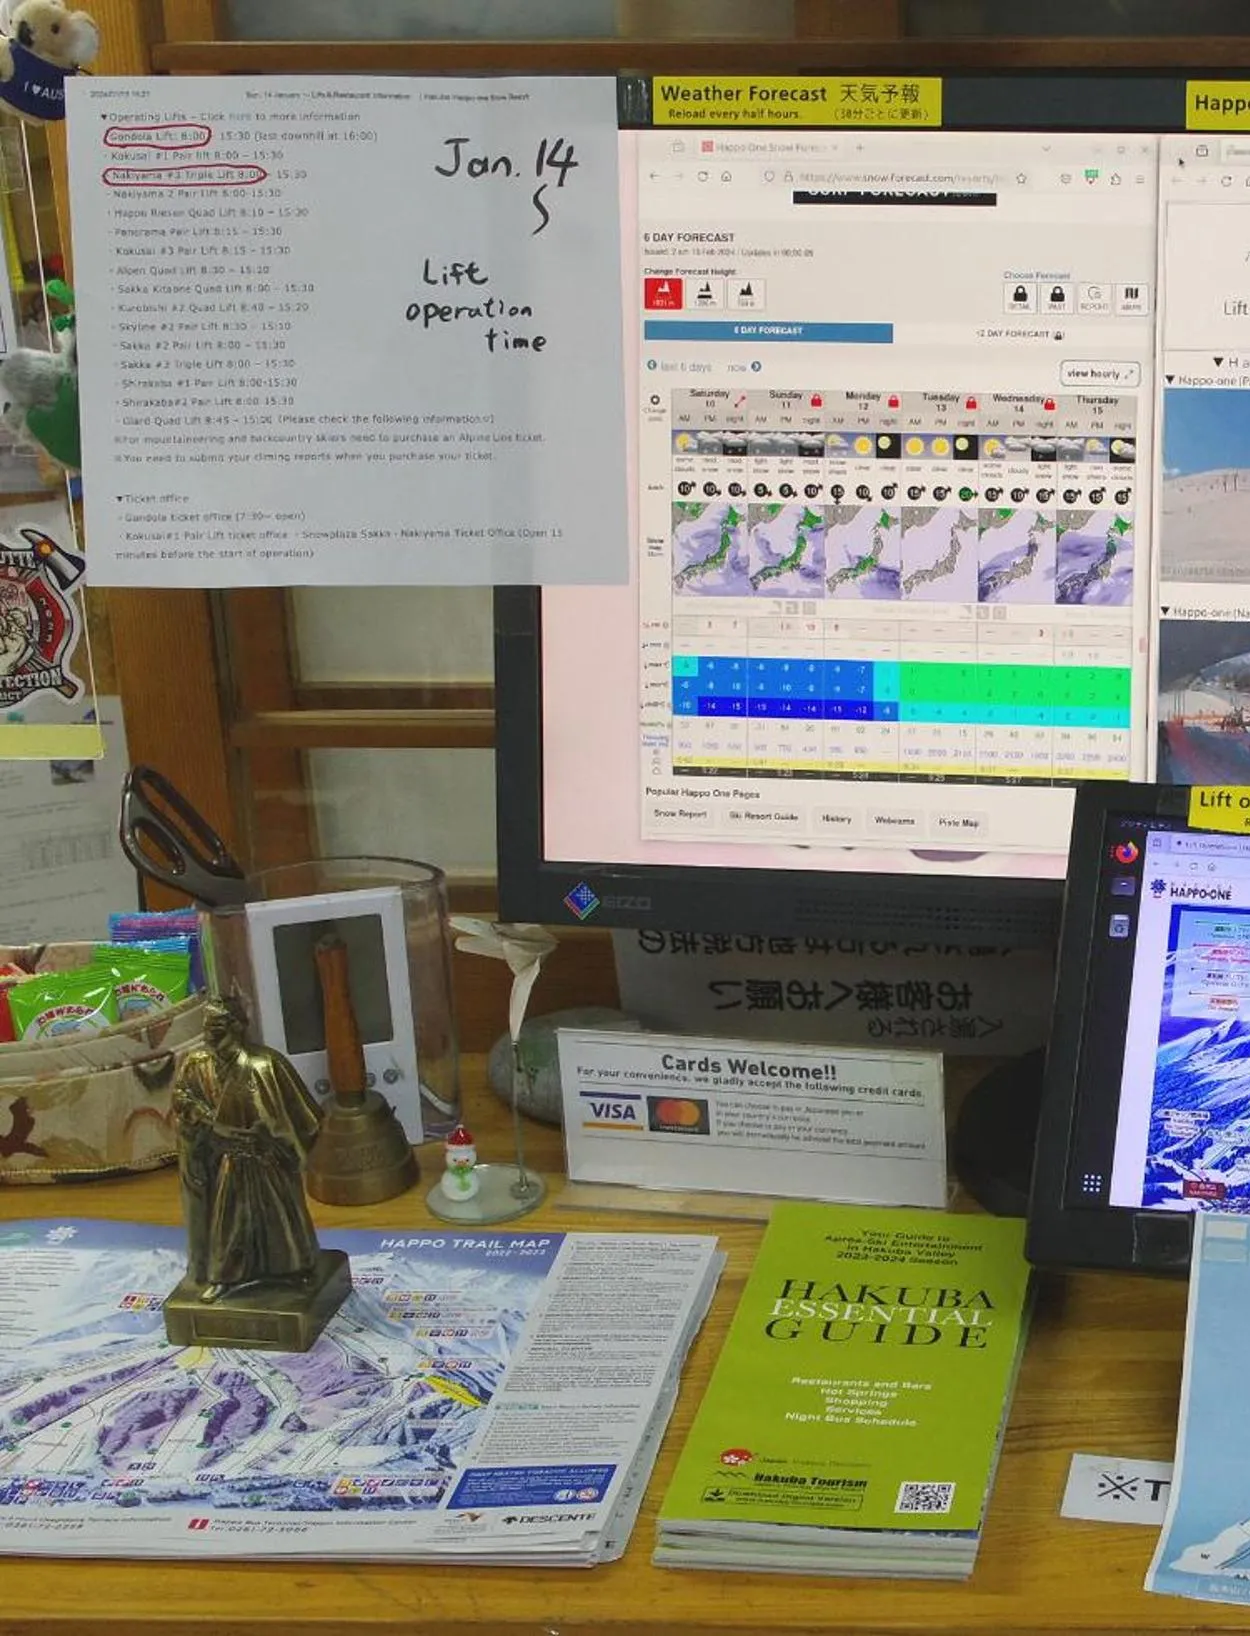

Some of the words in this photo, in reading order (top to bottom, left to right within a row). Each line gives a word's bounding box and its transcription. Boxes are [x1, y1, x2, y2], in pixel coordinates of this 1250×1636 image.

[661, 85, 741, 101] Weather
[749, 85, 827, 101] Forecast
[840, 84, 920, 103] 天気予報
[669, 108, 706, 119] Reload
[709, 109, 740, 121] every
[743, 108, 765, 119] half
[435, 138, 520, 178] Jan.
[536, 138, 579, 187] 14
[653, 233, 674, 242] DAY
[677, 233, 735, 242] FORECAST
[423, 259, 488, 286] Lift
[406, 298, 532, 328] operation
[1224, 301, 1249, 316] Lift
[741, 326, 756, 334] DAY
[759, 327, 803, 335] FORECAST
[485, 328, 547, 352] time
[690, 361, 712, 372] days
[1067, 370, 1088, 378] view
[1091, 369, 1120, 380] hourly
[690, 389, 729, 399] Saturday
[769, 390, 803, 400] Sunday
[846, 391, 881, 401] Monday
[923, 393, 960, 403] Tuesday
[993, 394, 1046, 404] Wednesday
[1077, 396, 1118, 405] Thursday
[646, 787, 679, 798] Popular
[681, 788, 711, 799] Happo
[713, 789, 731, 799] One
[733, 790, 760, 800] Pages
[1200, 791, 1232, 809] Lift
[654, 809, 676, 818] Snow
[679, 809, 707, 819] Report
[745, 812, 771, 820] Resort
[774, 813, 799, 821] Guide
[822, 814, 851, 824] History
[962, 818, 980, 829] Map
[661, 1054, 722, 1075] Cards
[727, 1059, 836, 1081] Welcome!!
[577, 1066, 594, 1077] For
[597, 1068, 620, 1079] your
[713, 1076, 744, 1088] gladly
[748, 1079, 782, 1092] accept
[785, 1080, 802, 1091] the
[805, 1081, 855, 1096] following
[858, 1085, 889, 1097] credit
[590, 1102, 637, 1121] VISA
[381, 1238, 446, 1249] HAPPO
[452, 1238, 504, 1249] TRAIL
[510, 1238, 550, 1249] MAP
[778, 1279, 996, 1310] HAKUBA
[770, 1299, 993, 1328] ESSENTIAL
[764, 1319, 988, 1349] GUIDE
[847, 1389, 898, 1398] Springs
[825, 1397, 888, 1407] Shopping
[826, 1406, 881, 1415] Services
[754, 1472, 807, 1485] Hakuba
[810, 1477, 868, 1488] Tourism
[519, 1513, 598, 1523] DESCENTE
